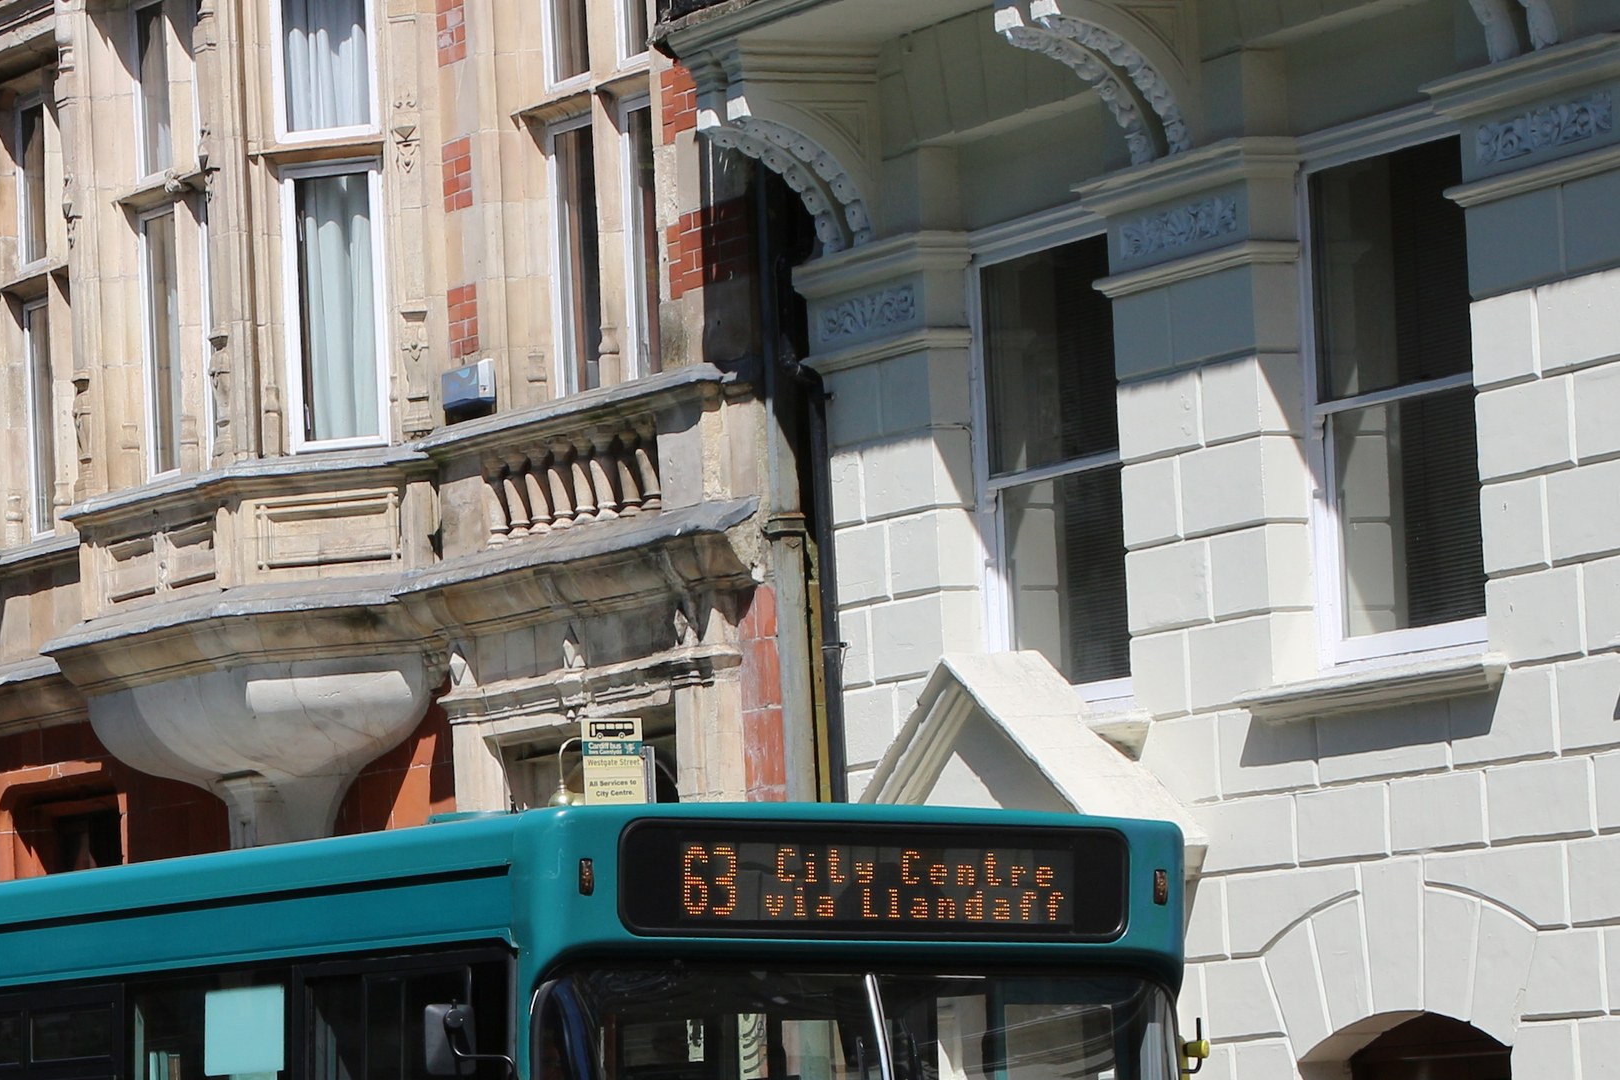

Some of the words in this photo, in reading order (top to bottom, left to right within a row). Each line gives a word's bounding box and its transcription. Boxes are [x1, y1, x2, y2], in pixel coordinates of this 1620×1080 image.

[587, 759, 618, 767] Westgate
[619, 758, 640, 766] Street
[596, 790, 609, 798] City
[600, 779, 628, 787] Services
[776, 847, 874, 885] City
[901, 850, 1055, 887] Centre
[683, 845, 738, 917] 63
[765, 886, 836, 918] via
[862, 888, 1064, 921] Llandaff
